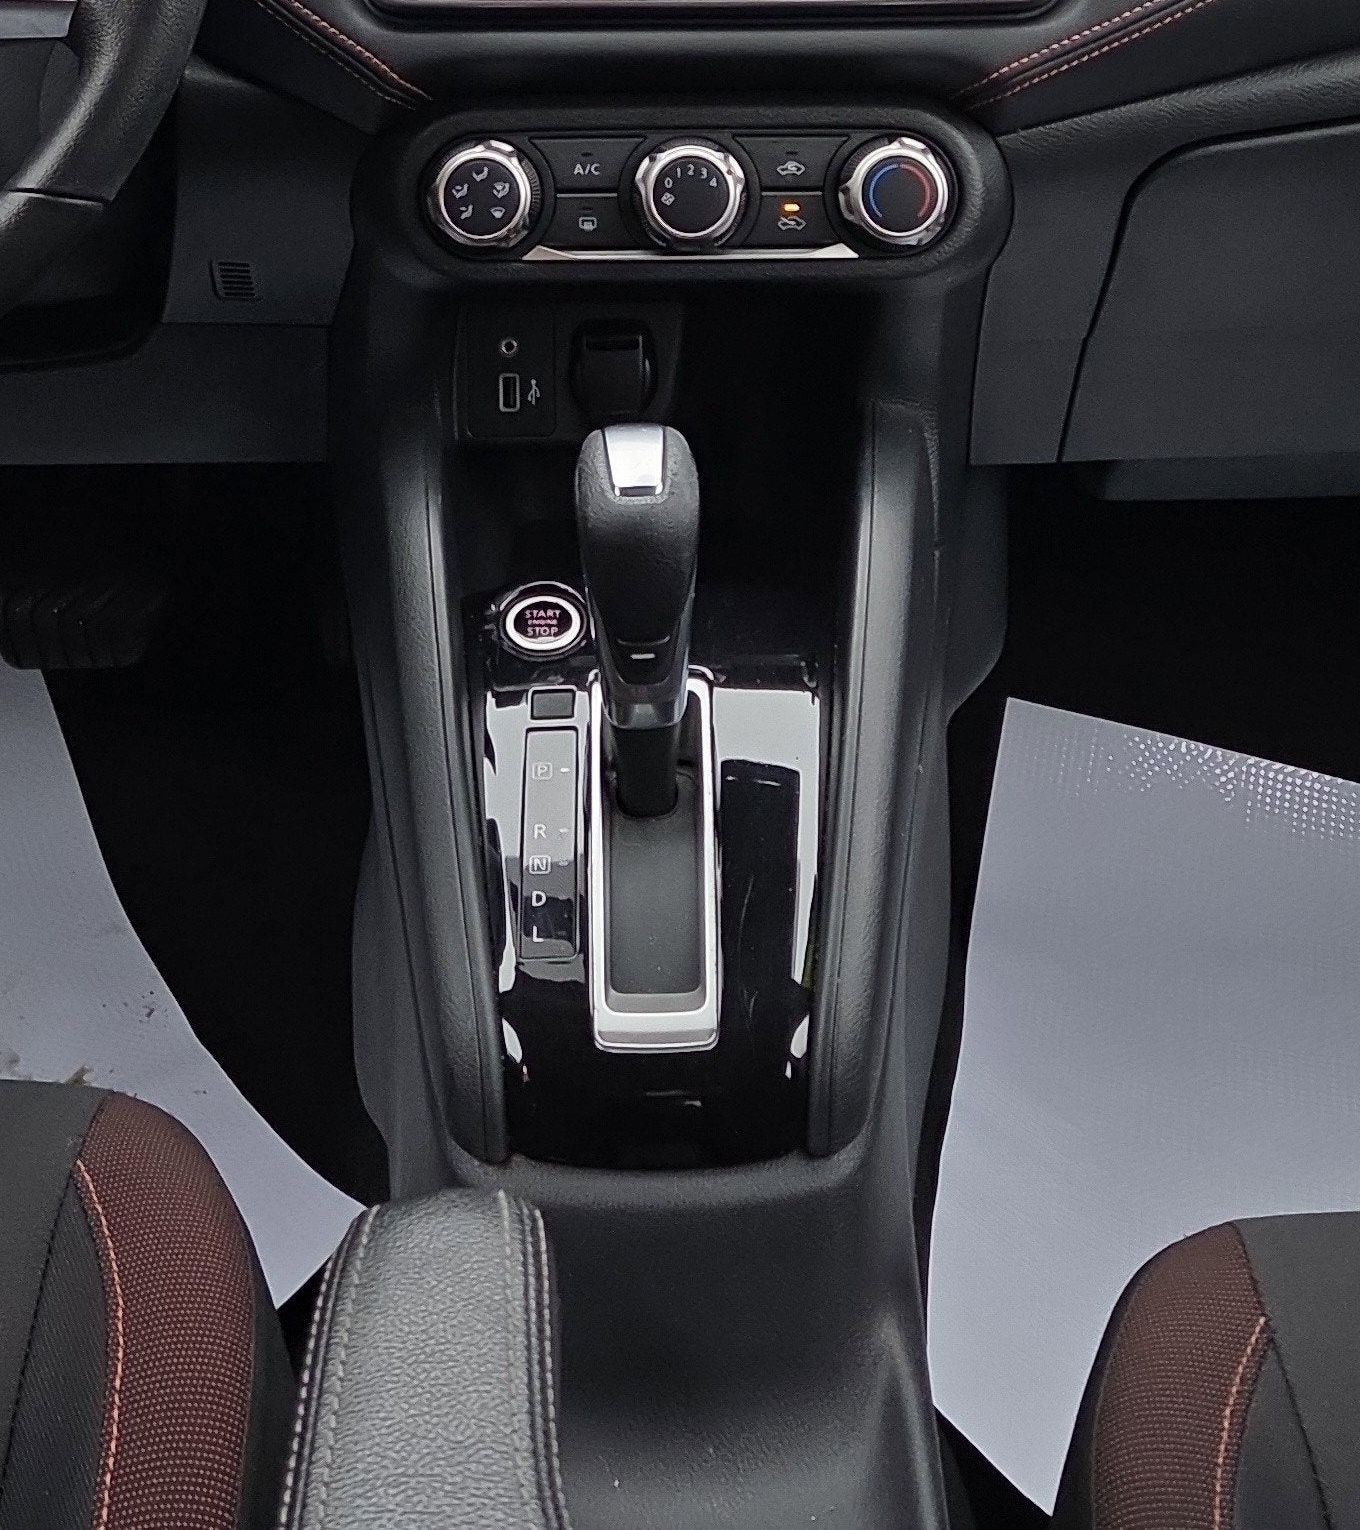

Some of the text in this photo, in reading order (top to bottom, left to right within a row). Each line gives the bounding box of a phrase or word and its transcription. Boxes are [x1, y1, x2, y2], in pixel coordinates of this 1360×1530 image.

[573, 163, 601, 176] A/C
[688, 164, 695, 176] 2
[700, 167, 708, 179] 3
[664, 177, 673, 189] 0
[709, 176, 718, 188] 4
[524, 609, 562, 619] START
[526, 626, 559, 637] STOP
[533, 824, 547, 839] R
[533, 857, 547, 871] N
[531, 891, 547, 907] D
[532, 925, 544, 943] L
